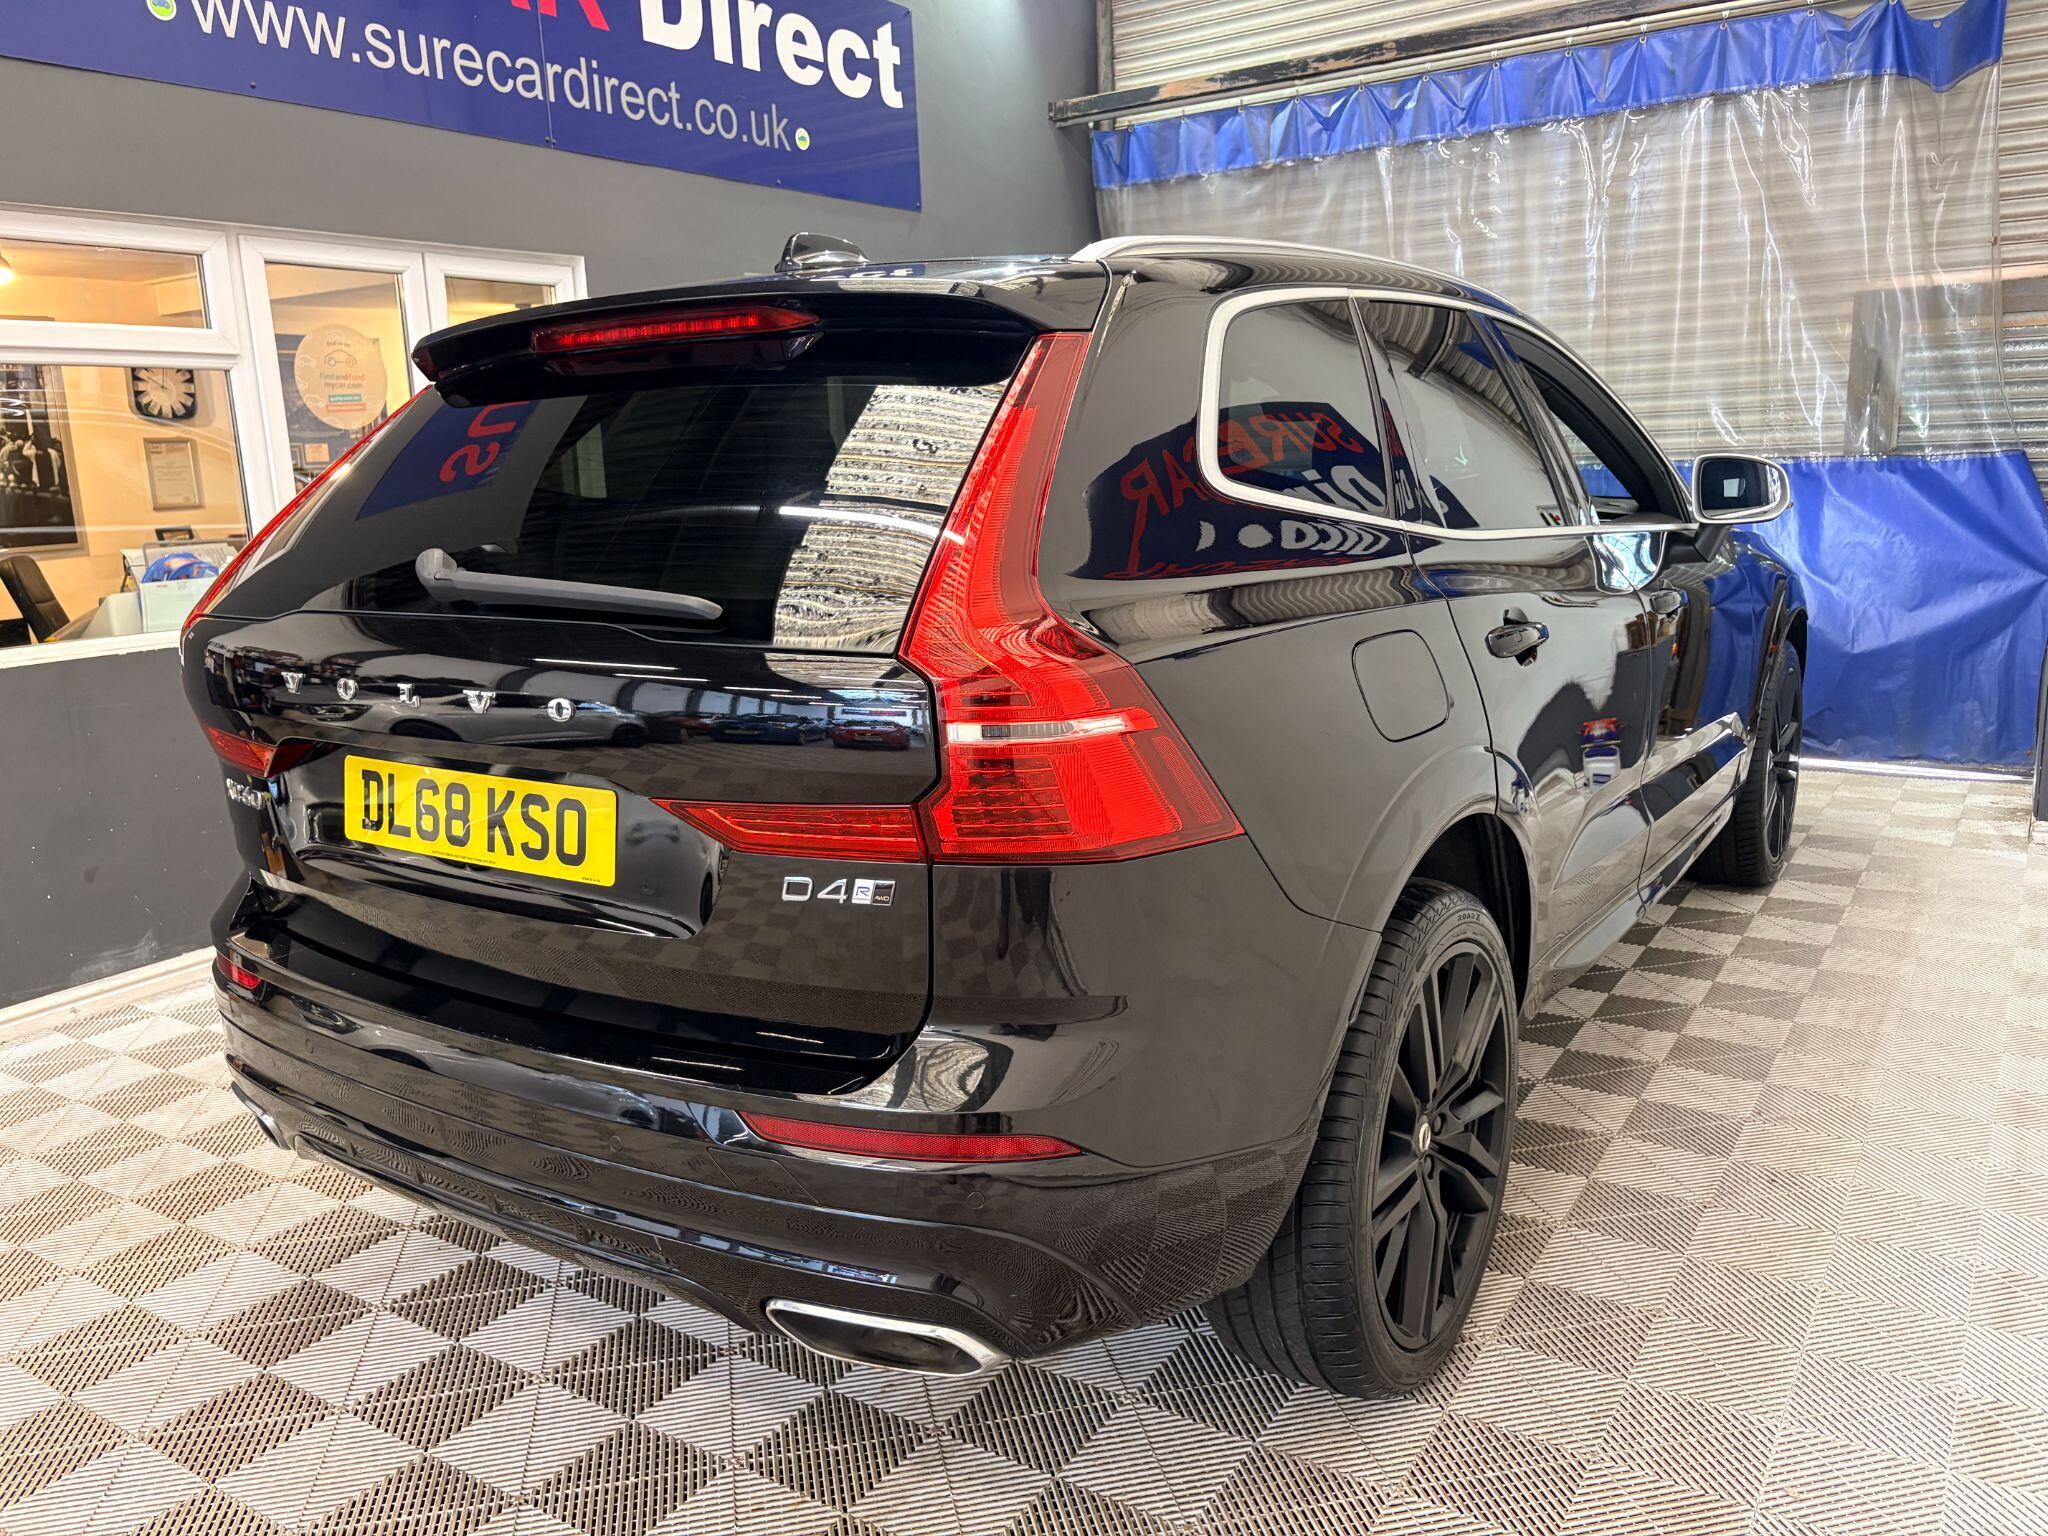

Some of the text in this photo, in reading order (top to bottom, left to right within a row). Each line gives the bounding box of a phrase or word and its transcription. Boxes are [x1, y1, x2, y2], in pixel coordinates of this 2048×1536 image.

[191, 0, 792, 152] www.surecardirect.co.uk
[281, 671, 576, 722] VOLVO
[361, 768, 587, 867] DL68 KSO
[781, 876, 848, 904] D4
